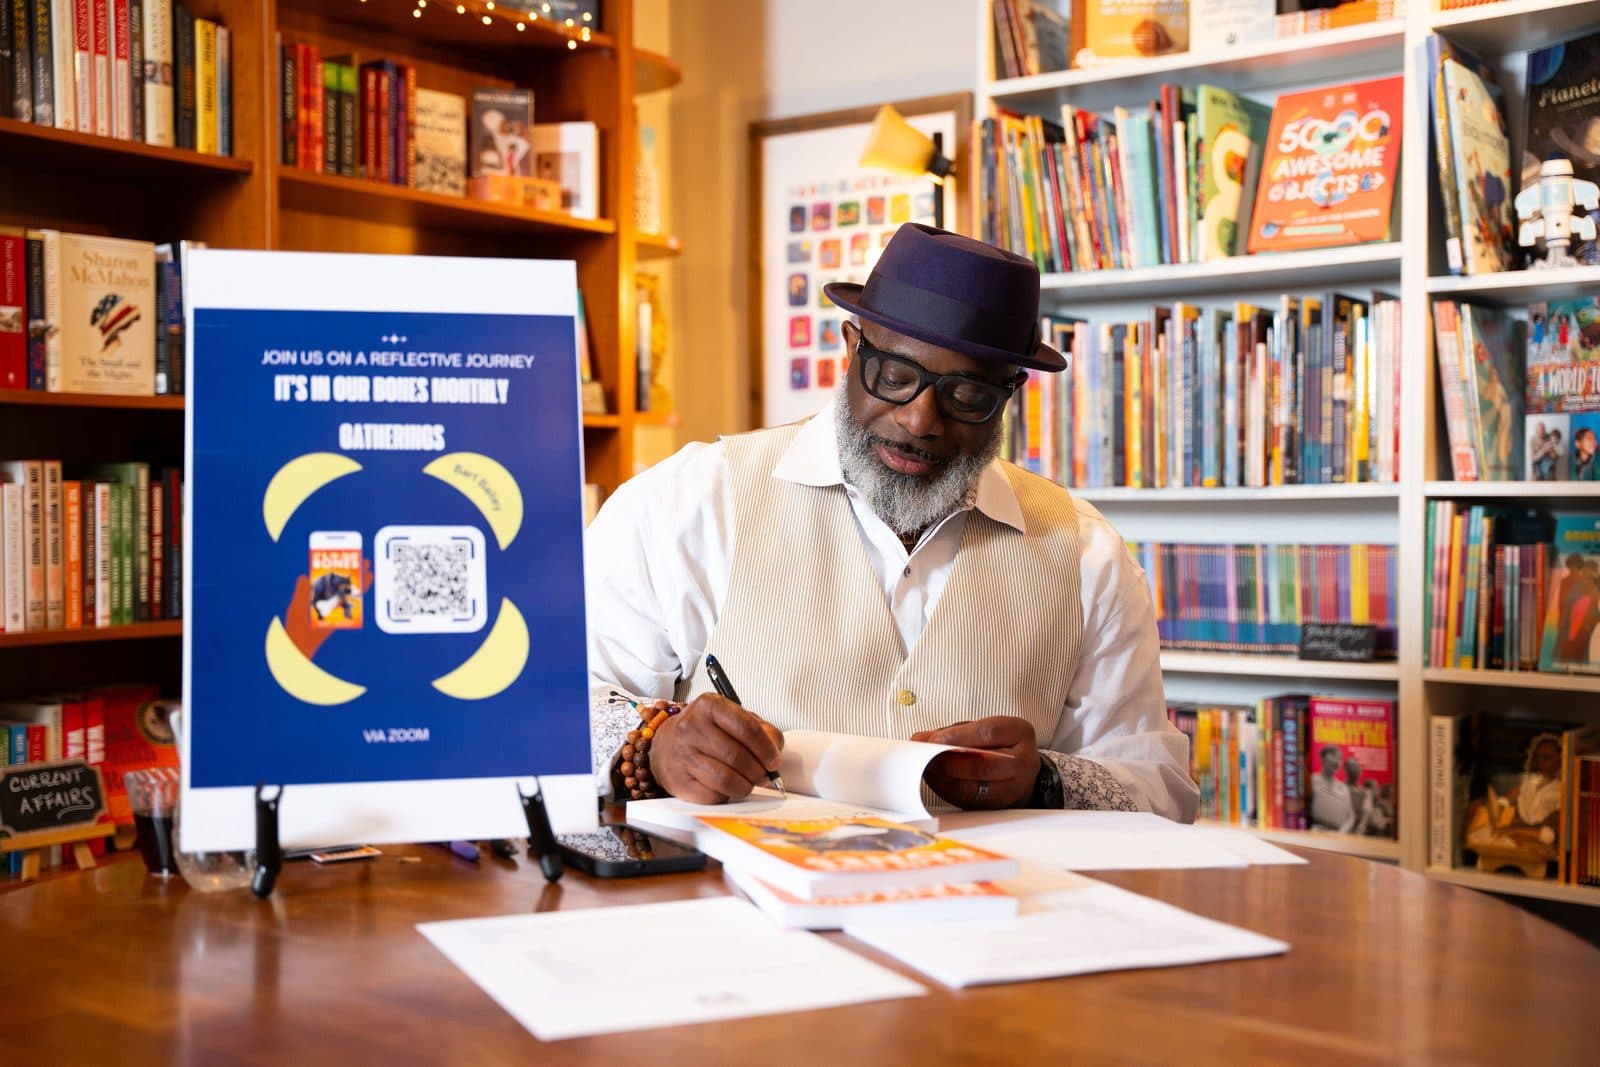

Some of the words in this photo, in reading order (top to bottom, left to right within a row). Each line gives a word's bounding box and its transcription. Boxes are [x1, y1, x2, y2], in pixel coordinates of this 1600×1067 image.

[1538, 78, 1600, 108] Planet
[1278, 110, 1390, 153] 5000
[1272, 146, 1385, 178] AWESOME
[1268, 173, 1359, 203] OBJECTS
[82, 250, 138, 271] Sharon
[70, 264, 150, 288] McMahon
[261, 349, 298, 365] JOIN
[300, 350, 324, 366] US
[326, 351, 352, 366] ON
[354, 351, 369, 366] A
[370, 352, 463, 368] REFLECTIVE
[465, 353, 535, 369] JOURNEY
[274, 375, 309, 402] IT'S
[311, 375, 331, 402] IN
[333, 376, 370, 402] OUR
[373, 376, 429, 403] BONES
[431, 377, 510, 404] MONTHLY
[338, 423, 446, 451] GATHERINGS
[363, 729, 387, 743] VIA
[388, 728, 430, 743] ZOOM
[9, 768, 85, 793] CURRENT
[20, 786, 96, 815] AFFAIRS
